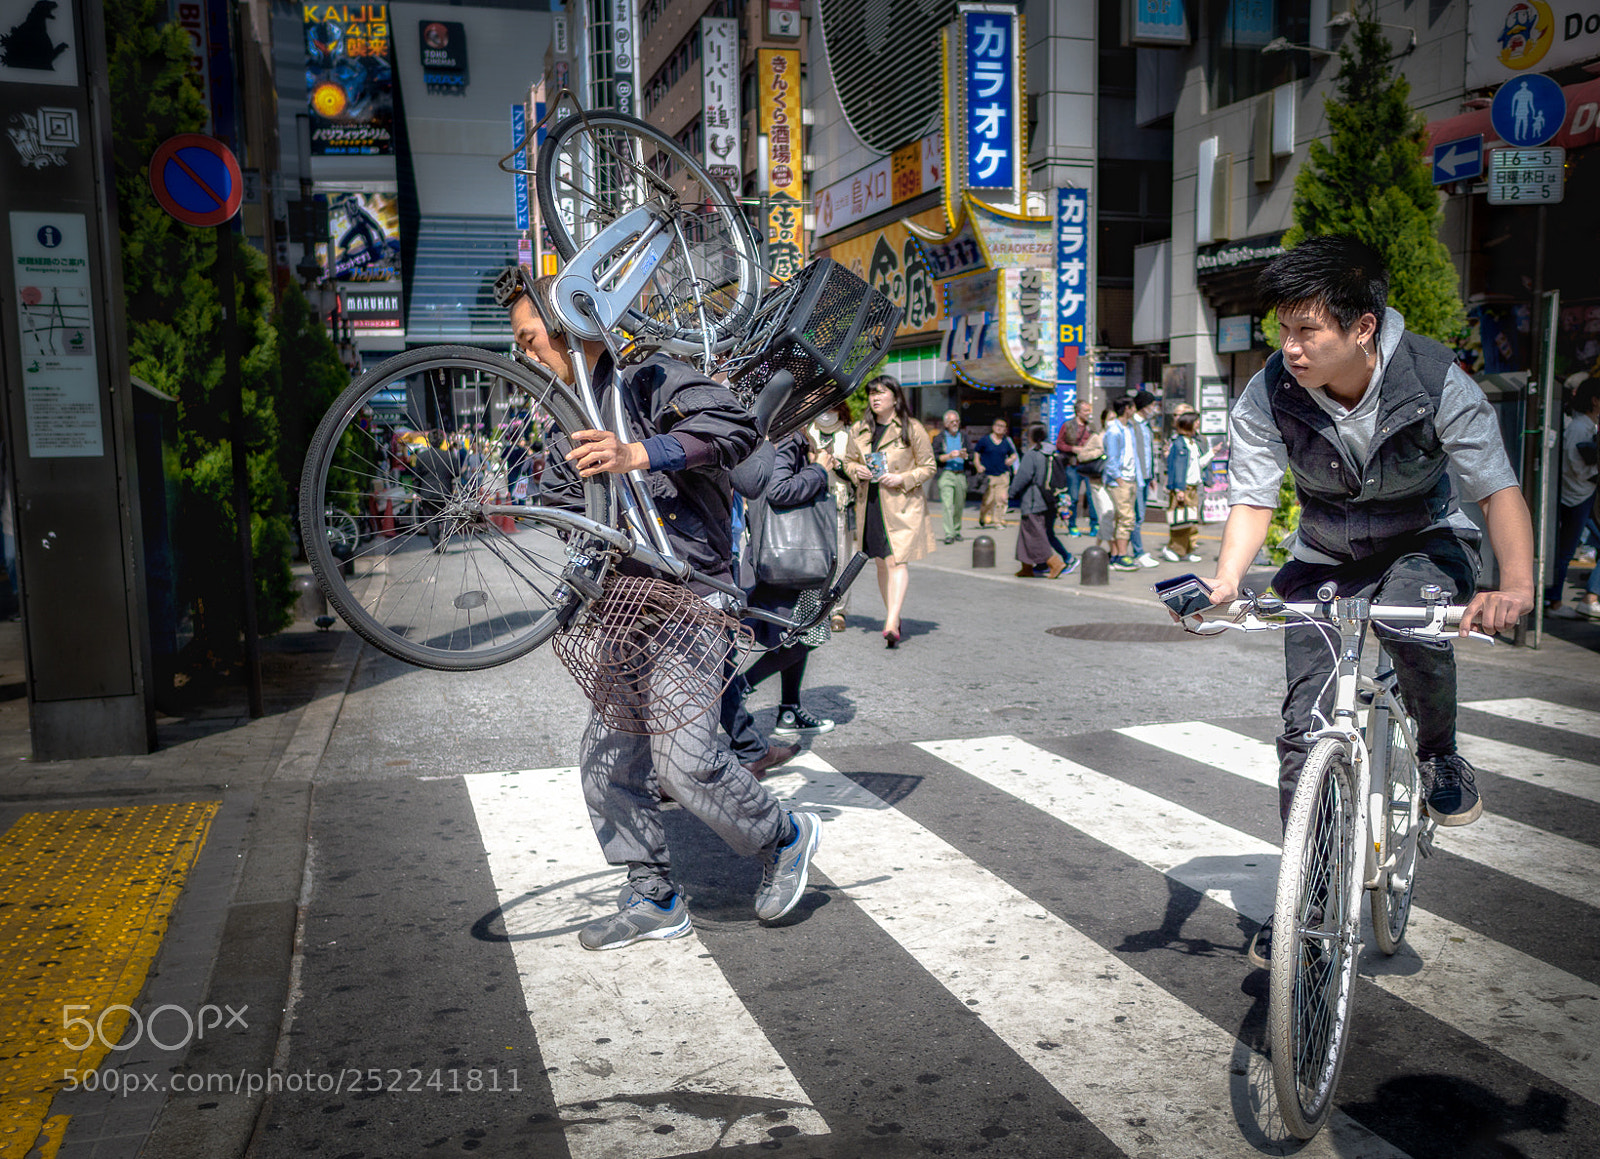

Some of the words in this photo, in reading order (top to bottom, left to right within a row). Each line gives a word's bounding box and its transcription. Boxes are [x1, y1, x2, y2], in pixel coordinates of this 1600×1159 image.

[303, 5, 387, 23] KAIJU
[346, 23, 387, 37] 4.13
[424, 49, 448, 58] TOHO
[424, 58, 456, 66] CINEMAS
[424, 73, 464, 85] IMAX
[973, 20, 1009, 180] カラオケ
[771, 55, 791, 164] きんくら酒場
[1059, 194, 1085, 318] カラオケ
[25, 266, 60, 274] Emergency
[347, 296, 398, 311] MARUHAN
[1019, 268, 1044, 371] カラオケ
[1060, 324, 1083, 343] B1
